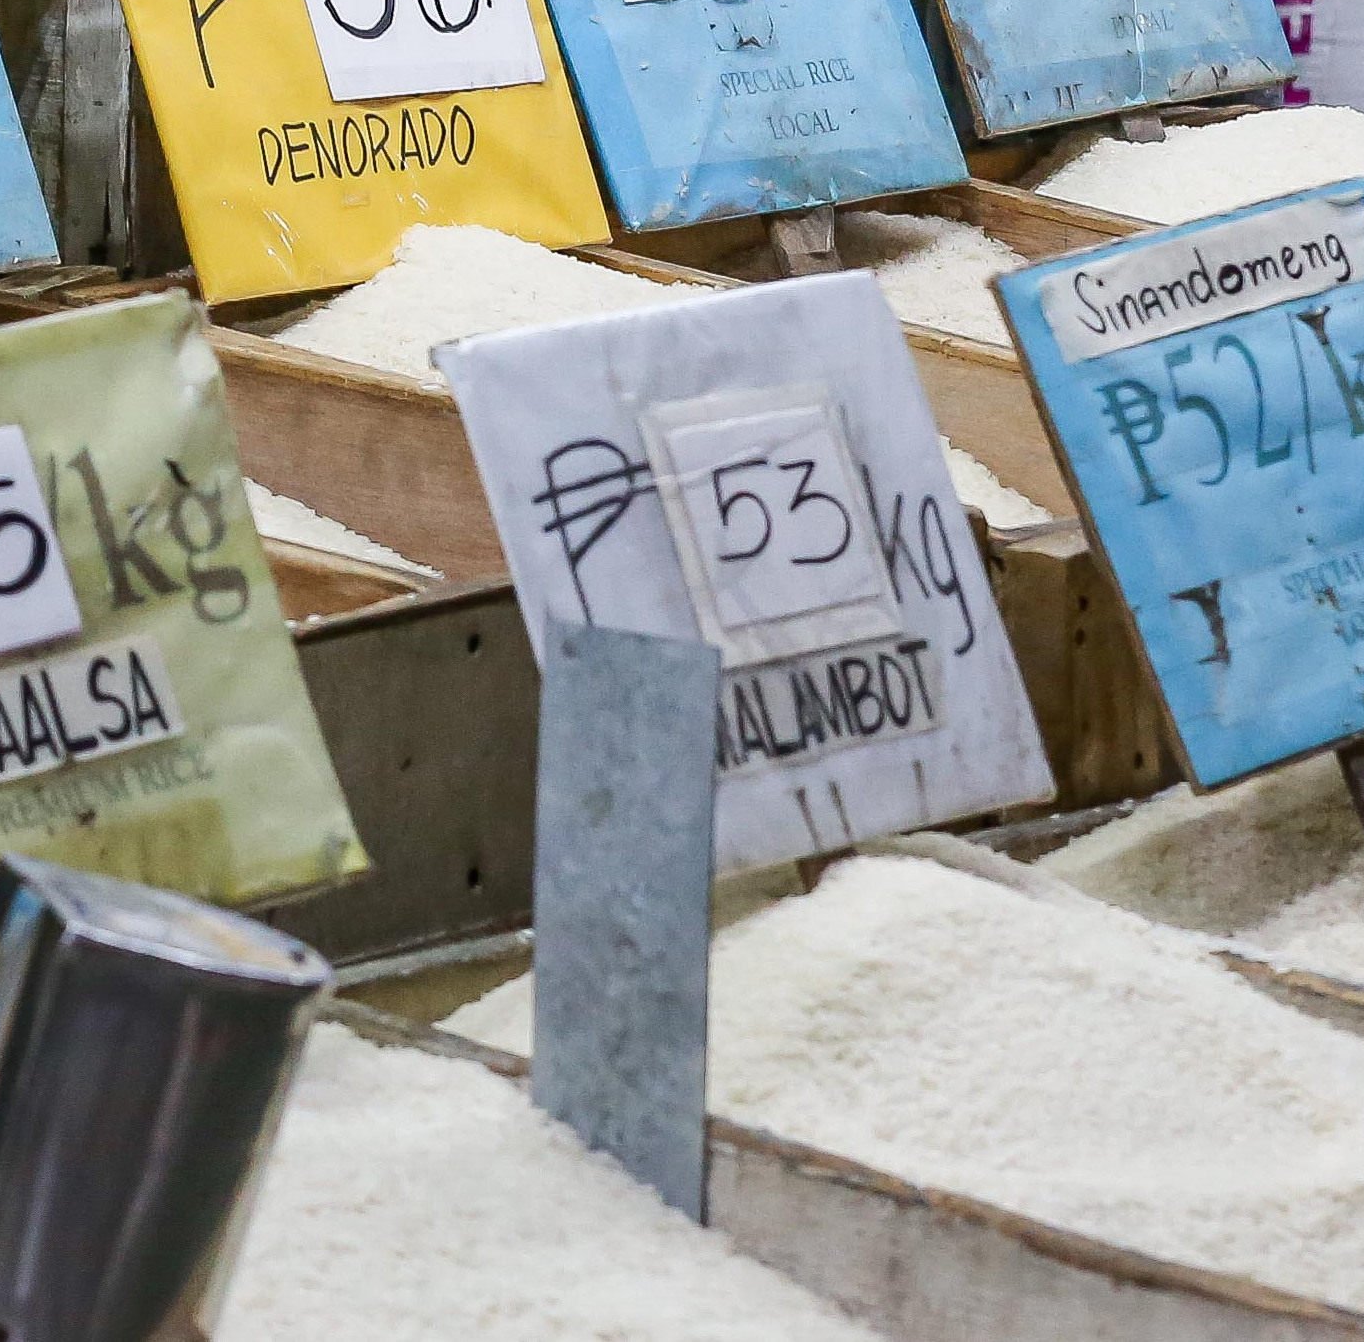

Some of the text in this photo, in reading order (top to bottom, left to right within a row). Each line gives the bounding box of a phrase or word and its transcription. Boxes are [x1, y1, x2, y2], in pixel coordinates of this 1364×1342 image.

[719, 59, 856, 99] SPECIAL RICE
[258, 105, 476, 186] DENORADO
[767, 113, 842, 140] LOCAL
